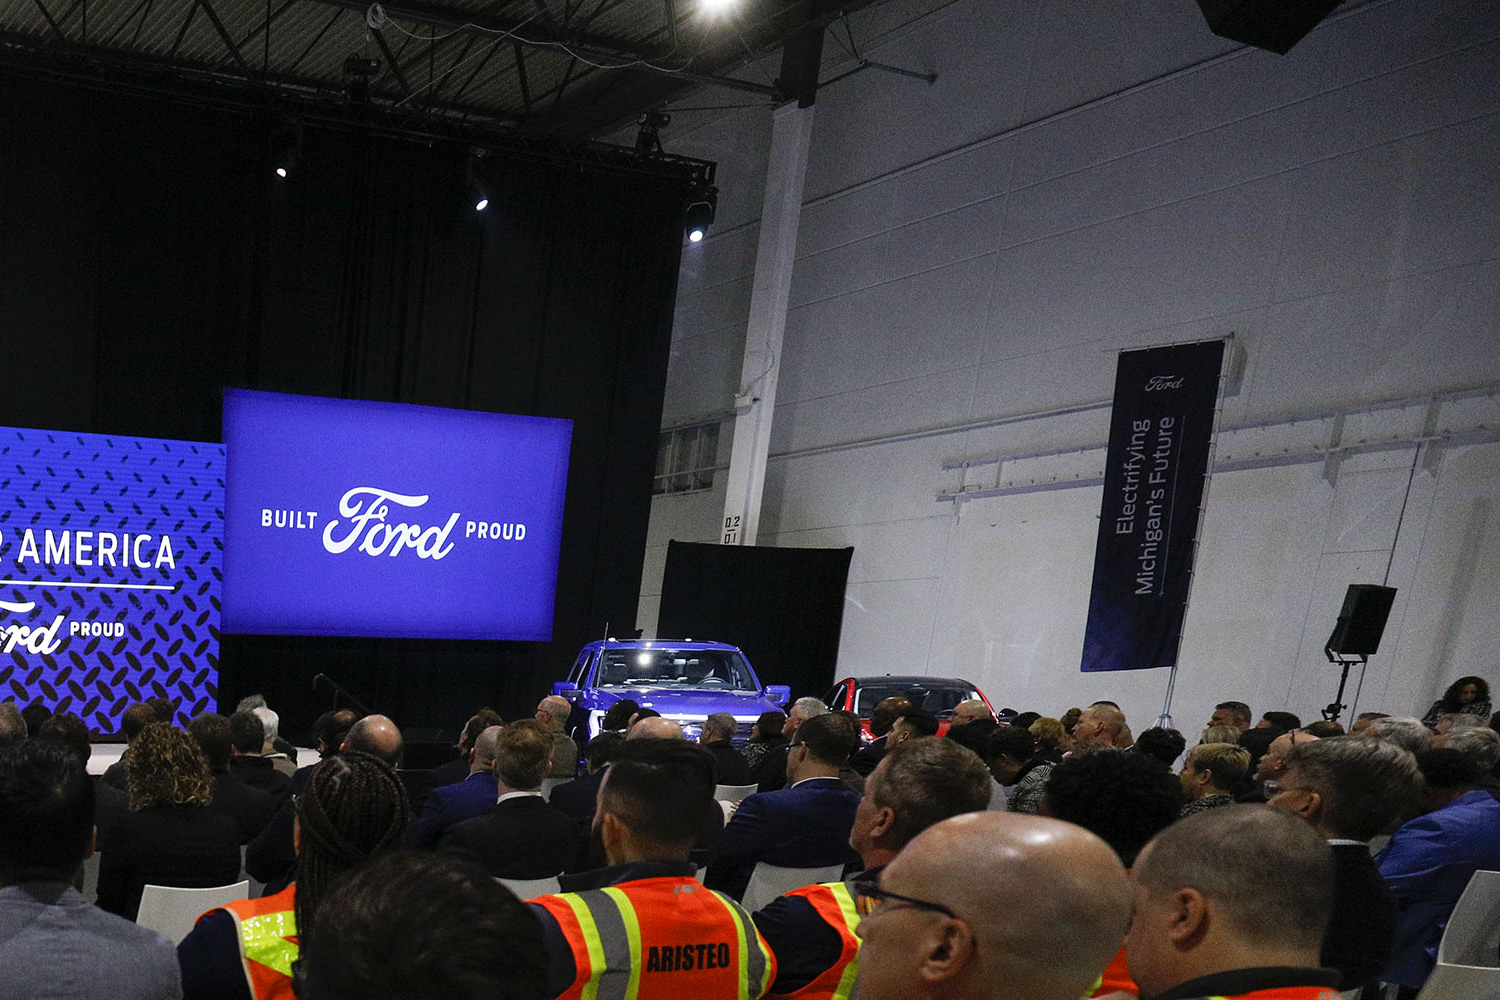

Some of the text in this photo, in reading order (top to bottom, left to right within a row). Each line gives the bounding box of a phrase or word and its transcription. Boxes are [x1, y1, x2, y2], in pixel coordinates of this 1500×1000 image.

[1144, 375, 1185, 392] Ford
[1147, 416, 1175, 484] Future
[1115, 418, 1151, 535] Electrifying
[261, 486, 527, 560] BUILT Ford PROUD
[17, 528, 176, 571] AMERICA
[70, 621, 126, 637] PROUD
[646, 942, 730, 972] ARISTEO
